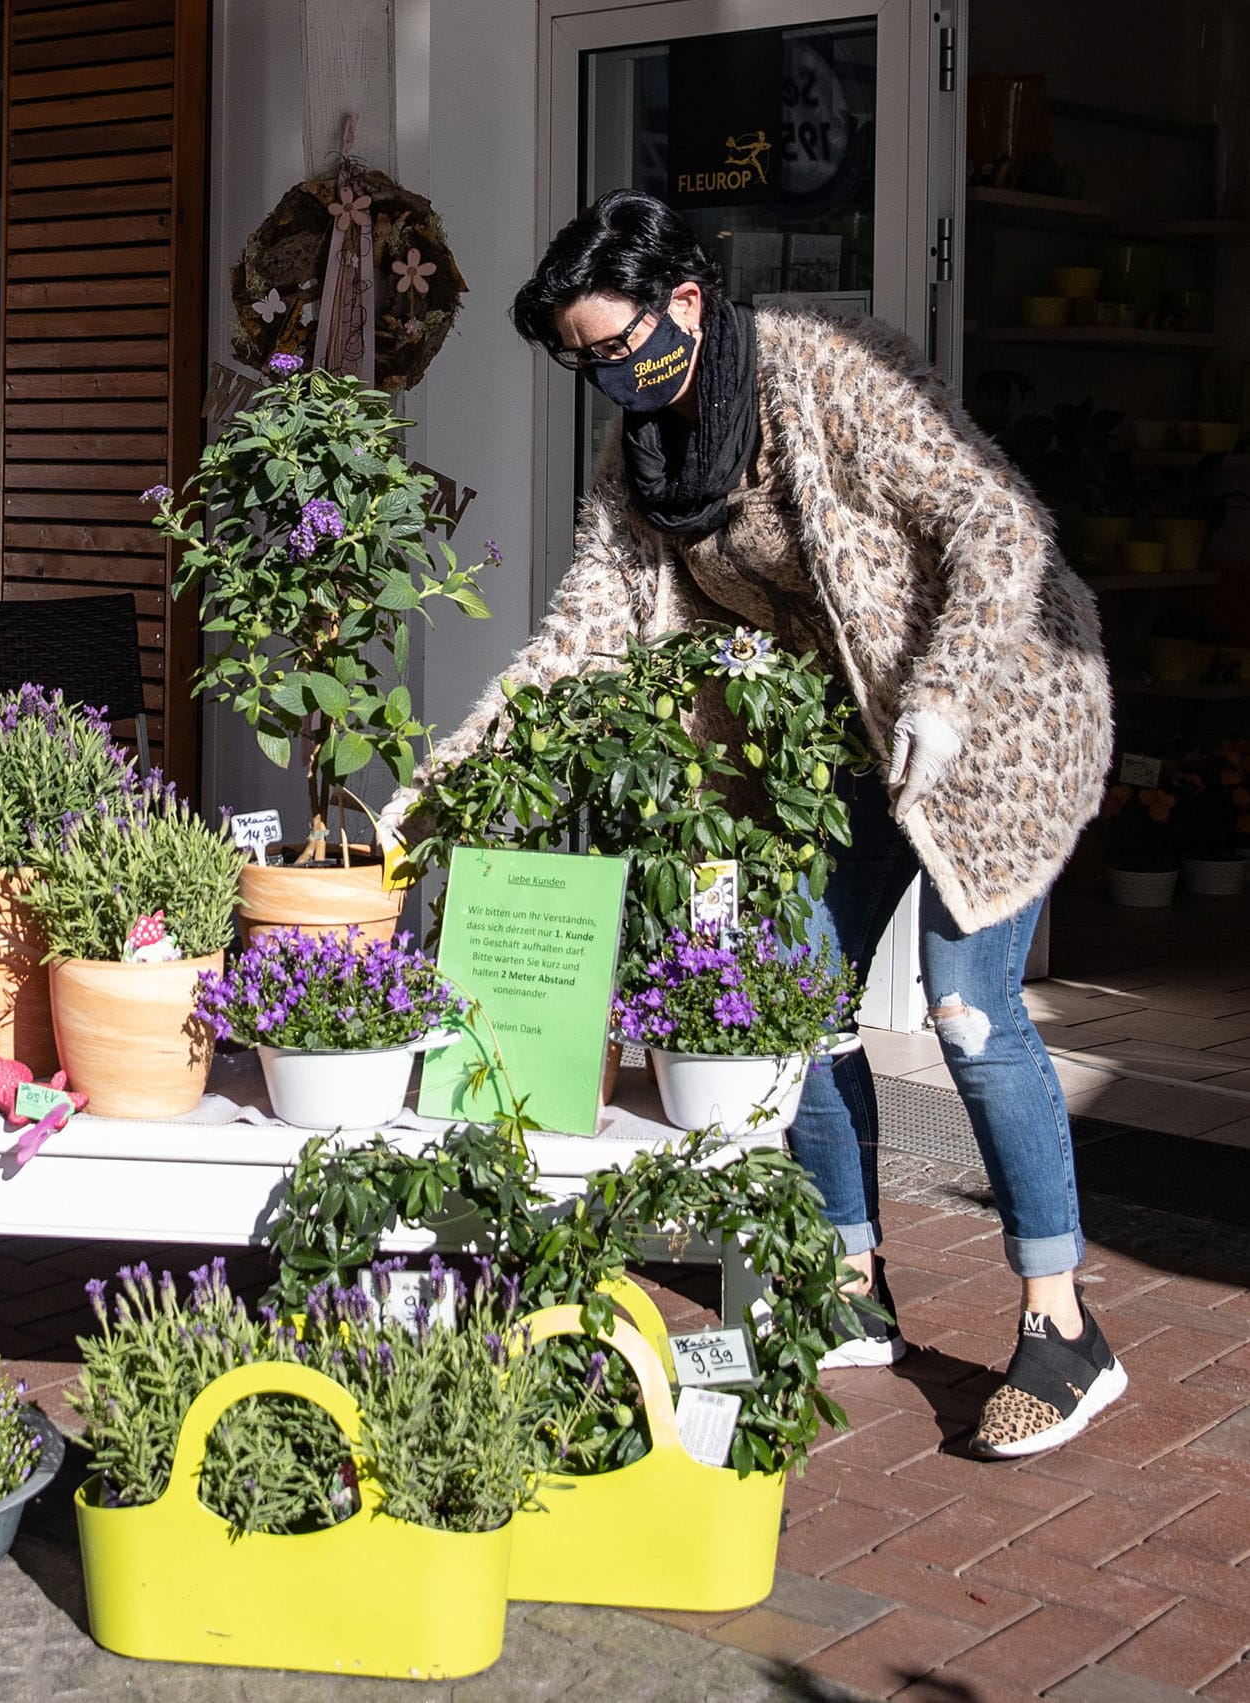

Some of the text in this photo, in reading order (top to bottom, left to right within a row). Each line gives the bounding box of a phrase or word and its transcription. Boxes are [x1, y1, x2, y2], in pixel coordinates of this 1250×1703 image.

[678, 171, 752, 192] FLEUROP
[633, 345, 686, 378] Blumen
[507, 873, 566, 888] Liebe Kunden
[468, 905, 597, 927] Wir bitten um Ihr Verständnis,
[466, 921, 594, 942] dass sich derzeit nur 1. Kunde
[469, 937, 586, 956] im Geschäft aufhalten darf.
[472, 952, 580, 972] Bitte warten Sie kurz und
[472, 967, 575, 986] halten 2 Meter Abstand
[493, 985, 549, 999] voneinander.
[492, 1020, 542, 1035] Vielen Dank
[1023, 1310, 1047, 1333] M
[691, 1347, 734, 1379] 9,99
